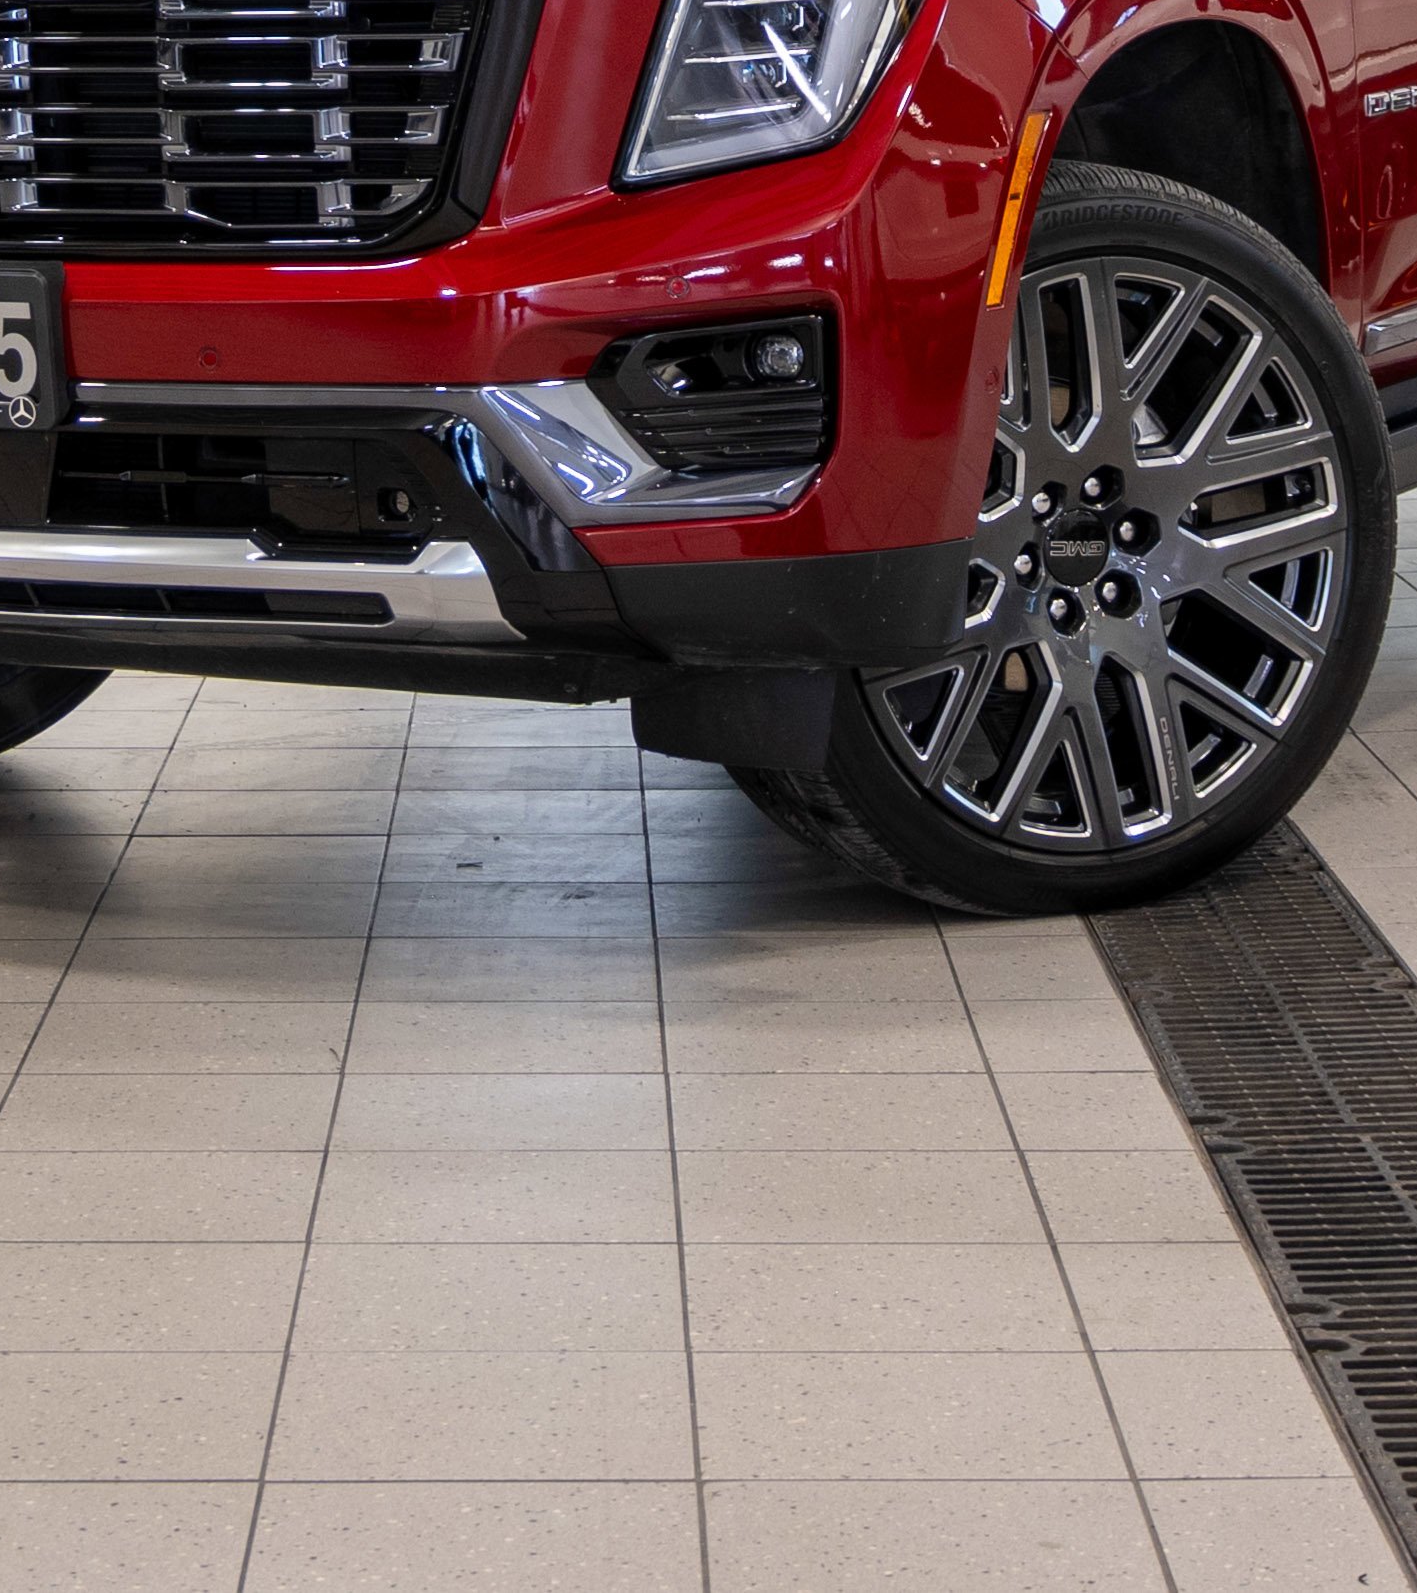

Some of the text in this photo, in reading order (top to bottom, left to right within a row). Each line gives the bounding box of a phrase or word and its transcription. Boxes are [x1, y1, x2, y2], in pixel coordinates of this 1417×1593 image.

[1041, 204, 1185, 230] BRIDGESTONE
[1049, 540, 1106, 557] GMC
[1159, 716, 1181, 801] DENALI
